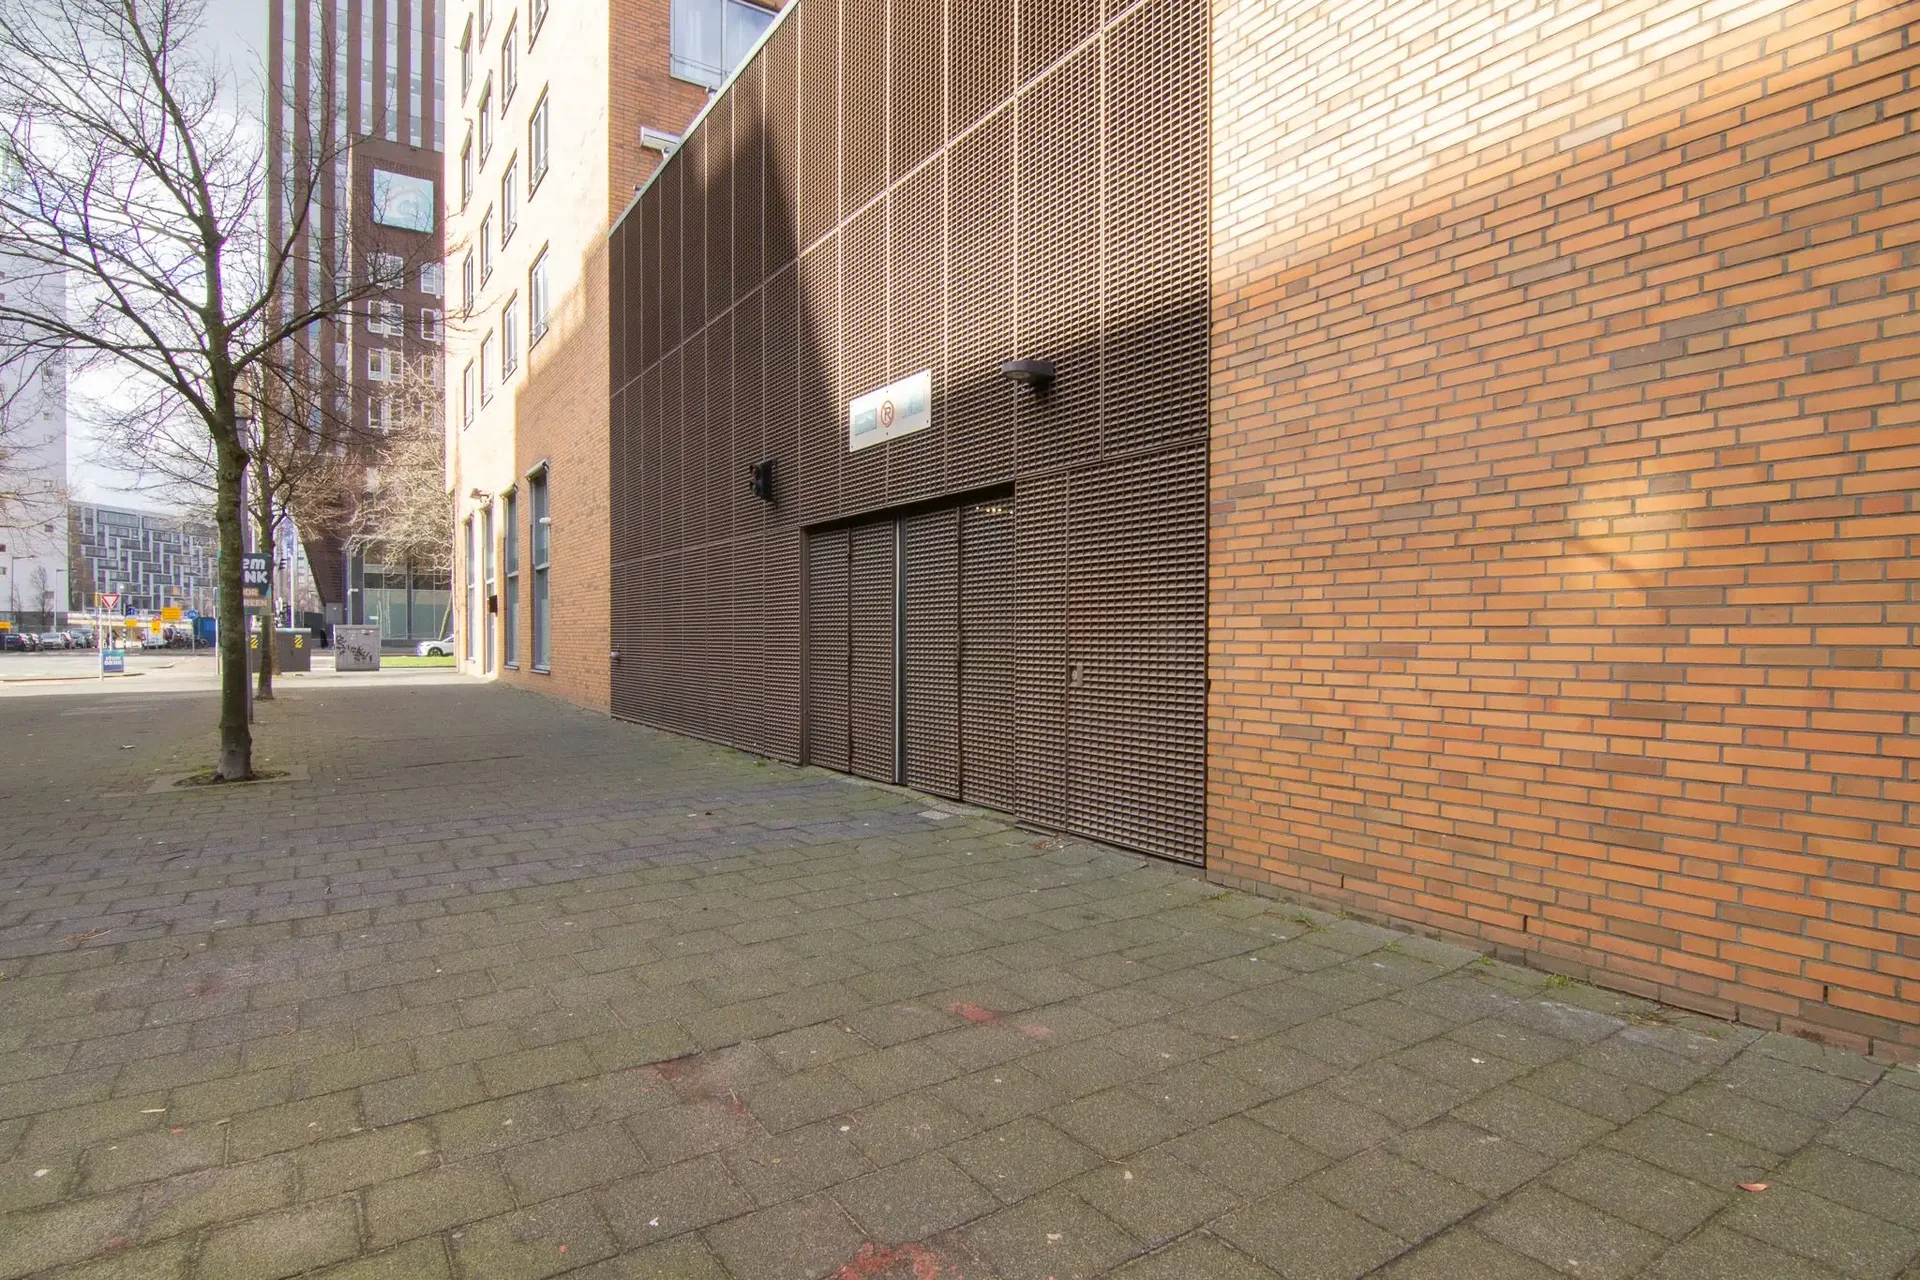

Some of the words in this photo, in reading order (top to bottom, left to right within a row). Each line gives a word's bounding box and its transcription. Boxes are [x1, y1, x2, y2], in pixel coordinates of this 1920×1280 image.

[242, 559, 265, 569] em
[244, 571, 268, 584] NK
[243, 599, 267, 607] REEN
